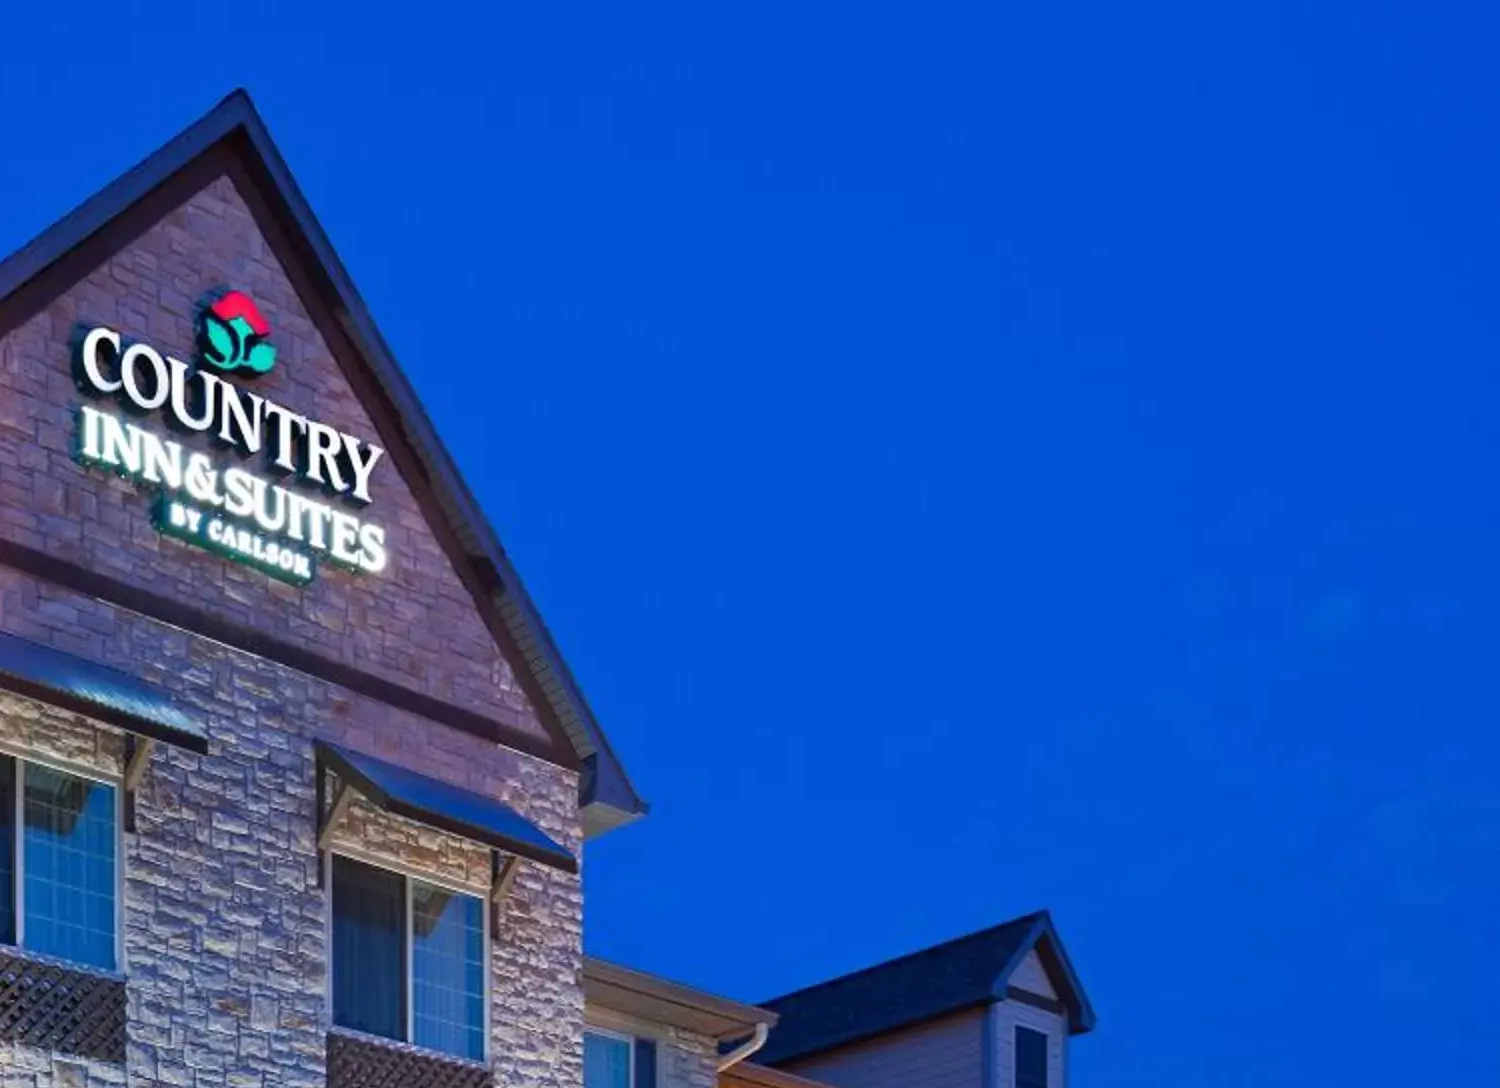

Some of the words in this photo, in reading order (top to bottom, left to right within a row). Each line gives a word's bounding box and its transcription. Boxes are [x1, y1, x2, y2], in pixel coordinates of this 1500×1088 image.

[82, 327, 384, 503] COUNTRY
[169, 502, 202, 533] BY
[207, 519, 312, 579] CARLSON
